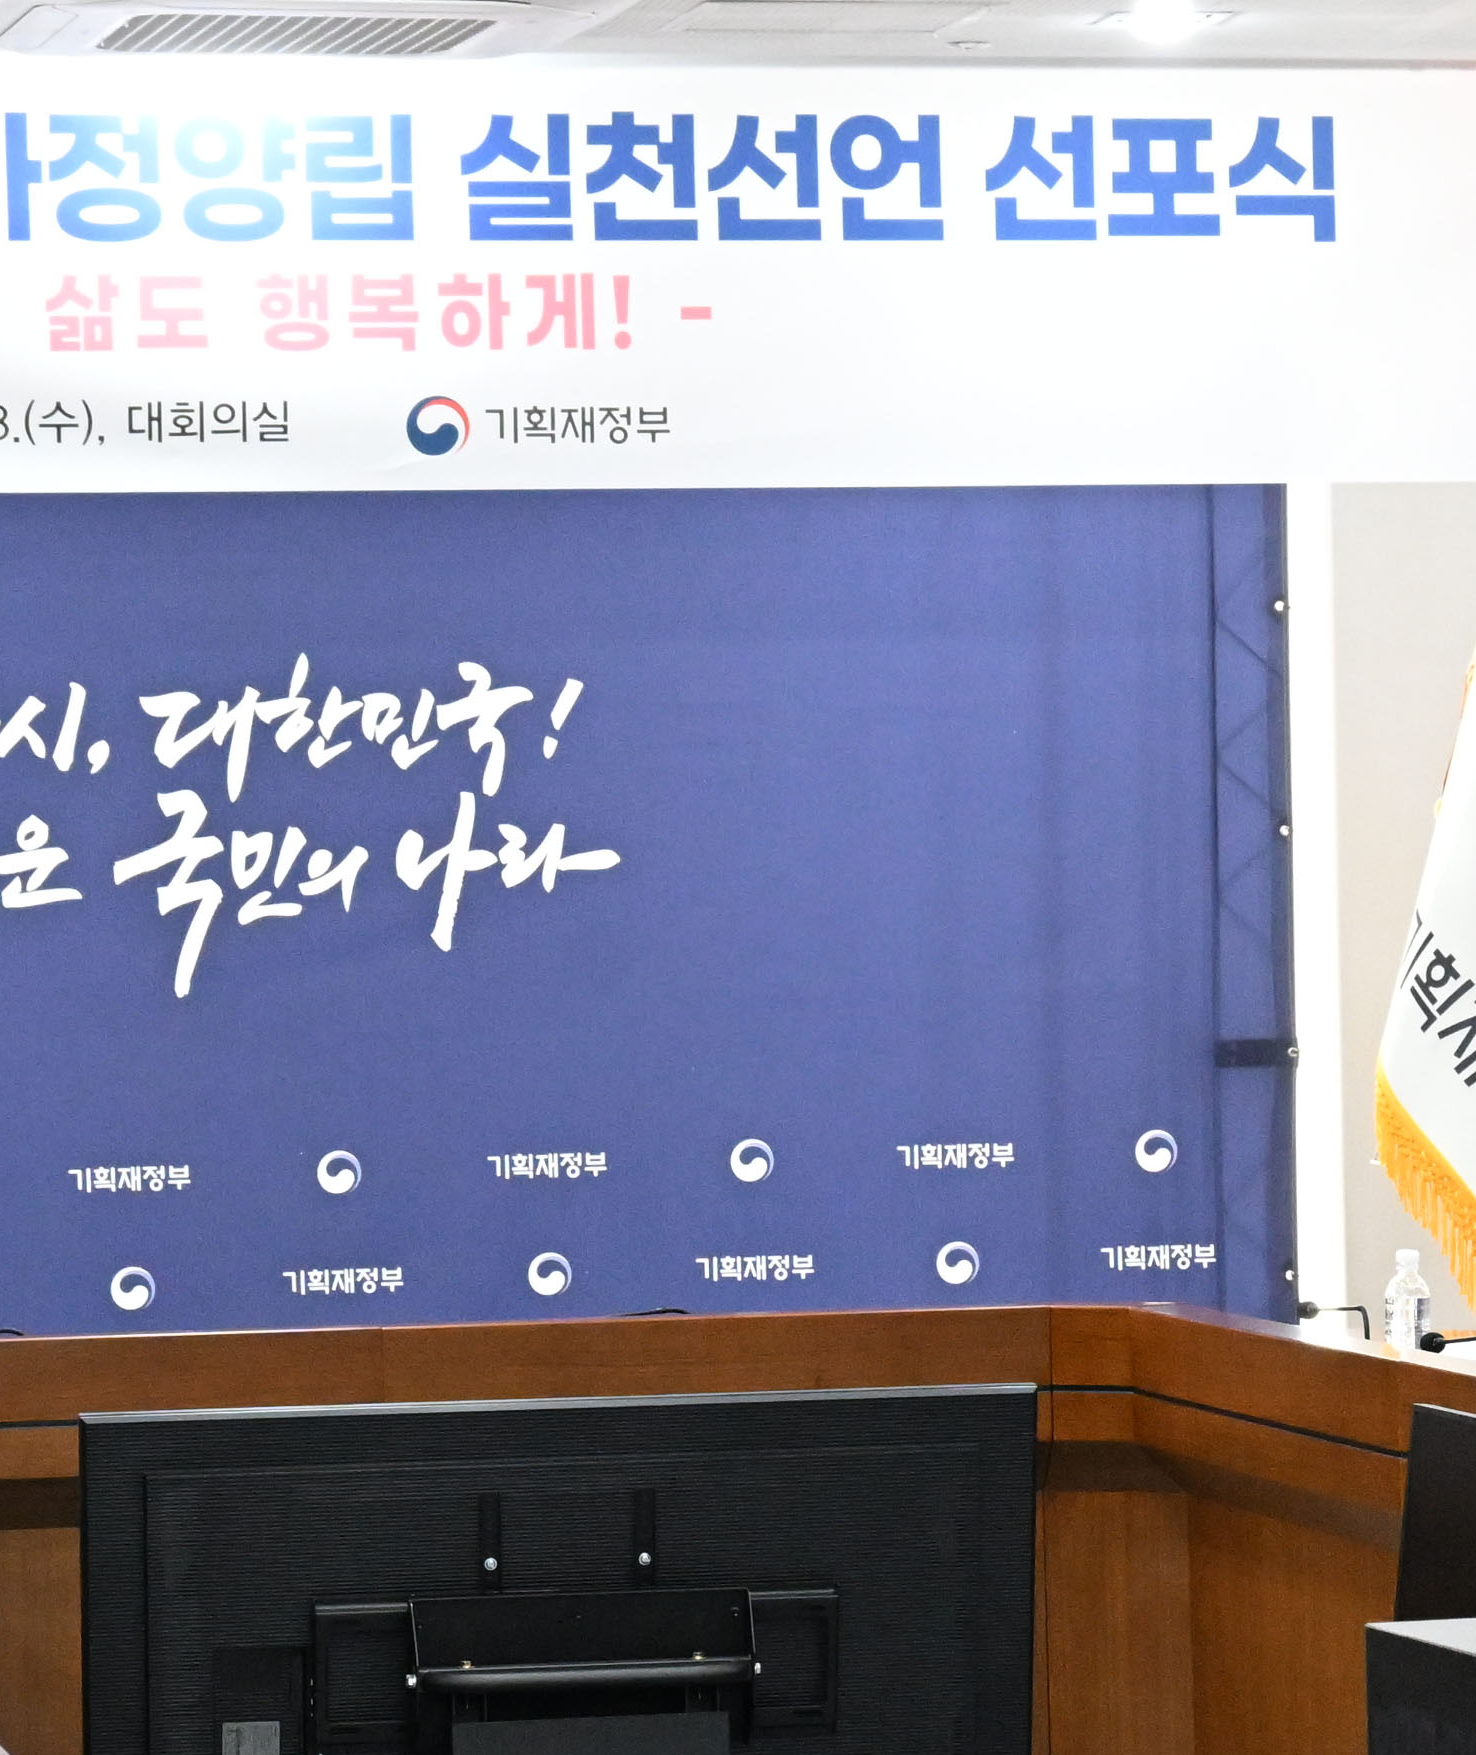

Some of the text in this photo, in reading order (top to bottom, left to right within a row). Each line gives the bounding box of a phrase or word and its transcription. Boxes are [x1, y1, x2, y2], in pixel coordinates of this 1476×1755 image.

[460, 112, 945, 242] 실천선언
[985, 115, 1337, 242] 선포식
[46, 274, 207, 352] 삶도
[262, 273, 633, 352] 행복하게!
[127, 400, 290, 443] 대회의실
[486, 405, 671, 445] 기획재정부
[138, 652, 584, 802] 대한민국!
[113, 789, 370, 999] 국민의
[394, 792, 621, 952] 나라
[488, 1152, 608, 1179] 기획재정부
[897, 1142, 1014, 1169] 기획재정부
[68, 1165, 191, 1192] 기획재정부
[696, 1254, 815, 1282] 기획재정부
[1101, 1243, 1217, 1270] 기획재정부
[283, 1267, 404, 1295] 기획재정부
